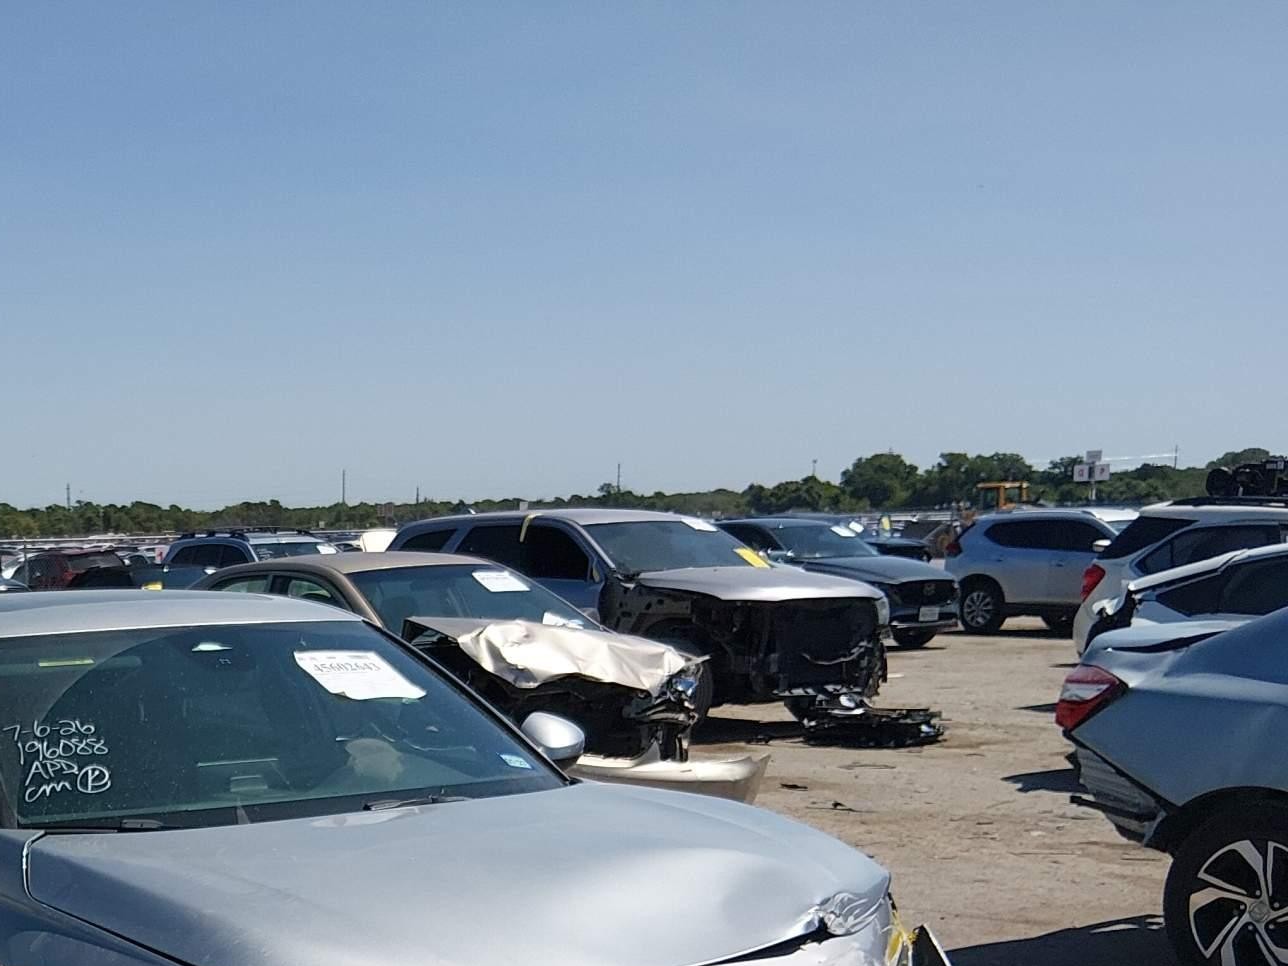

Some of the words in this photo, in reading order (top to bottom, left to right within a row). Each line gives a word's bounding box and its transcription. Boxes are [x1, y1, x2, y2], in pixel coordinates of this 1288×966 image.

[2, 719, 95, 741] 7-6-26
[17, 737, 108, 765] 196088
[24, 759, 79, 786] APD
